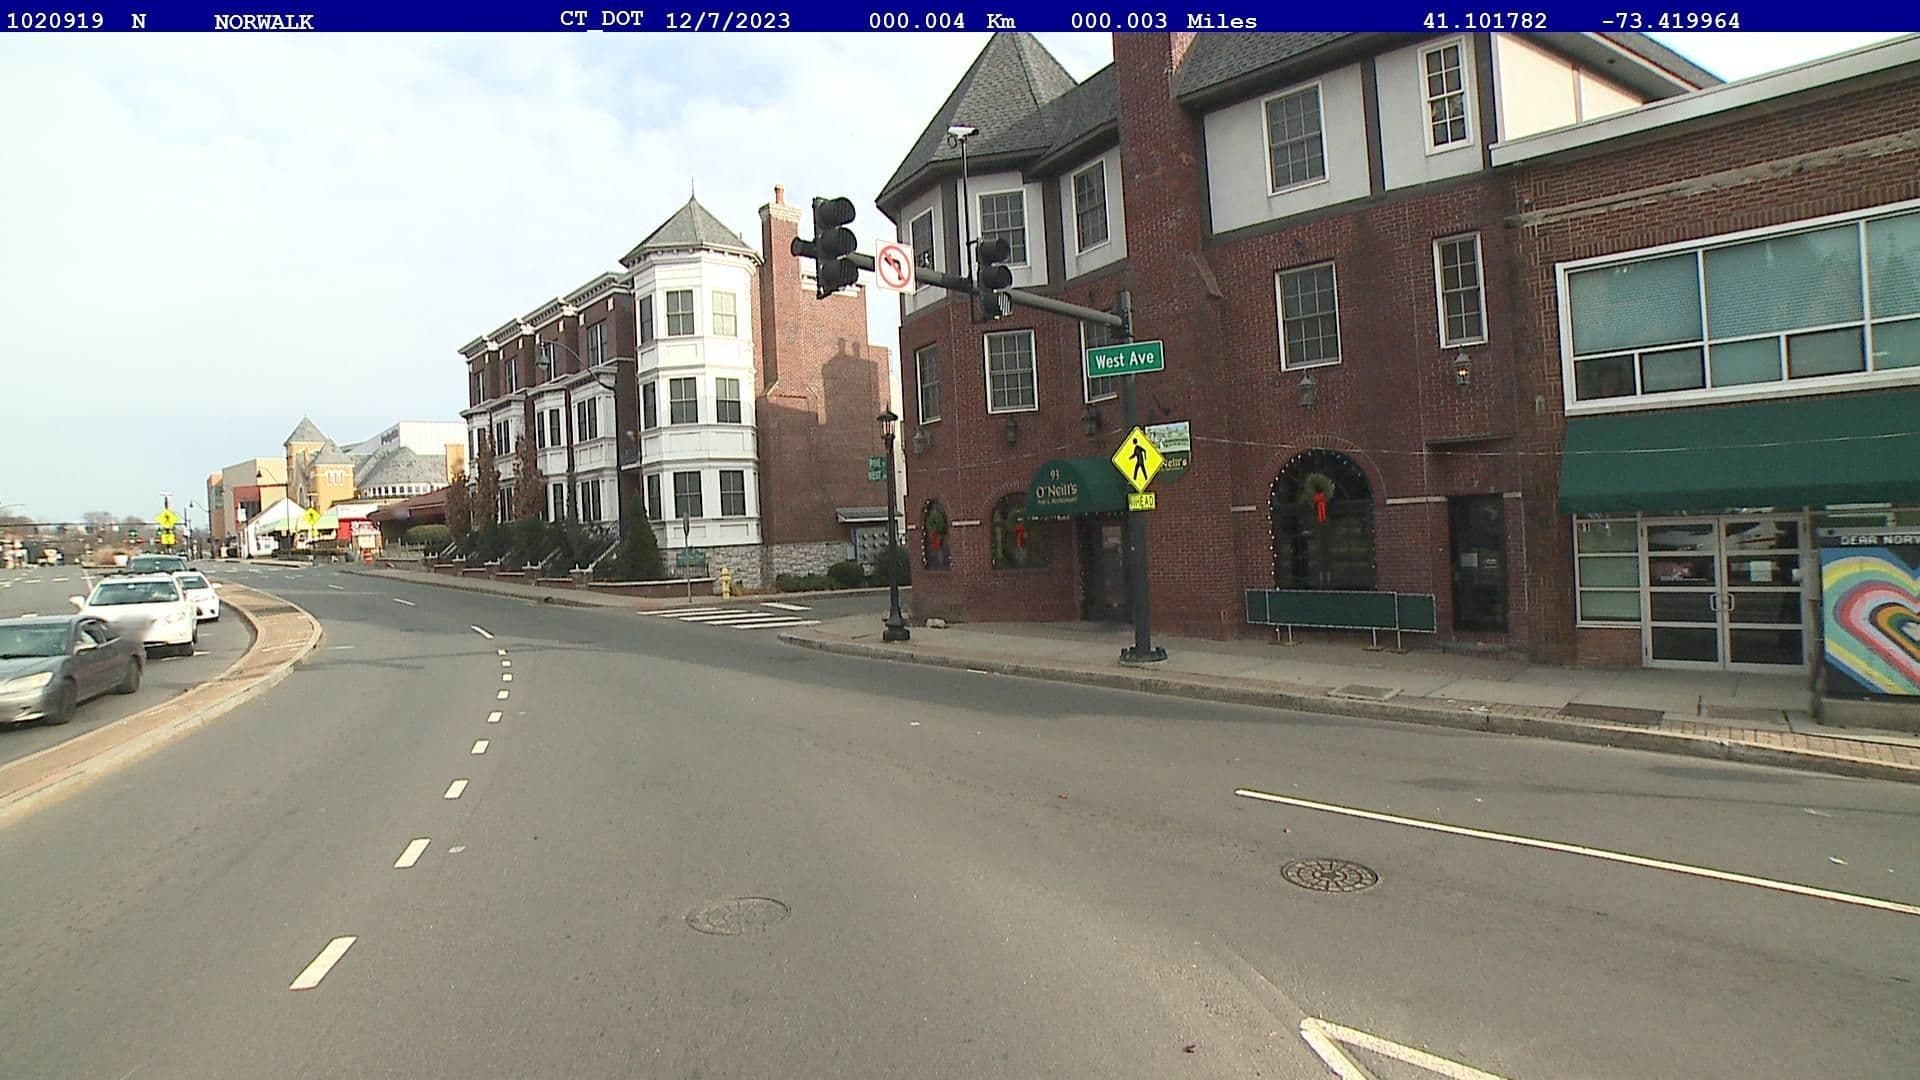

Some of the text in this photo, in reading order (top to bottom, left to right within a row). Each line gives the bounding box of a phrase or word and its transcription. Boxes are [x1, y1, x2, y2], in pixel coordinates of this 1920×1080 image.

[1096, 351, 1154, 369] West Ave
[1036, 481, 1078, 498] O'Neill's
[1840, 536, 1878, 545] DEAR
